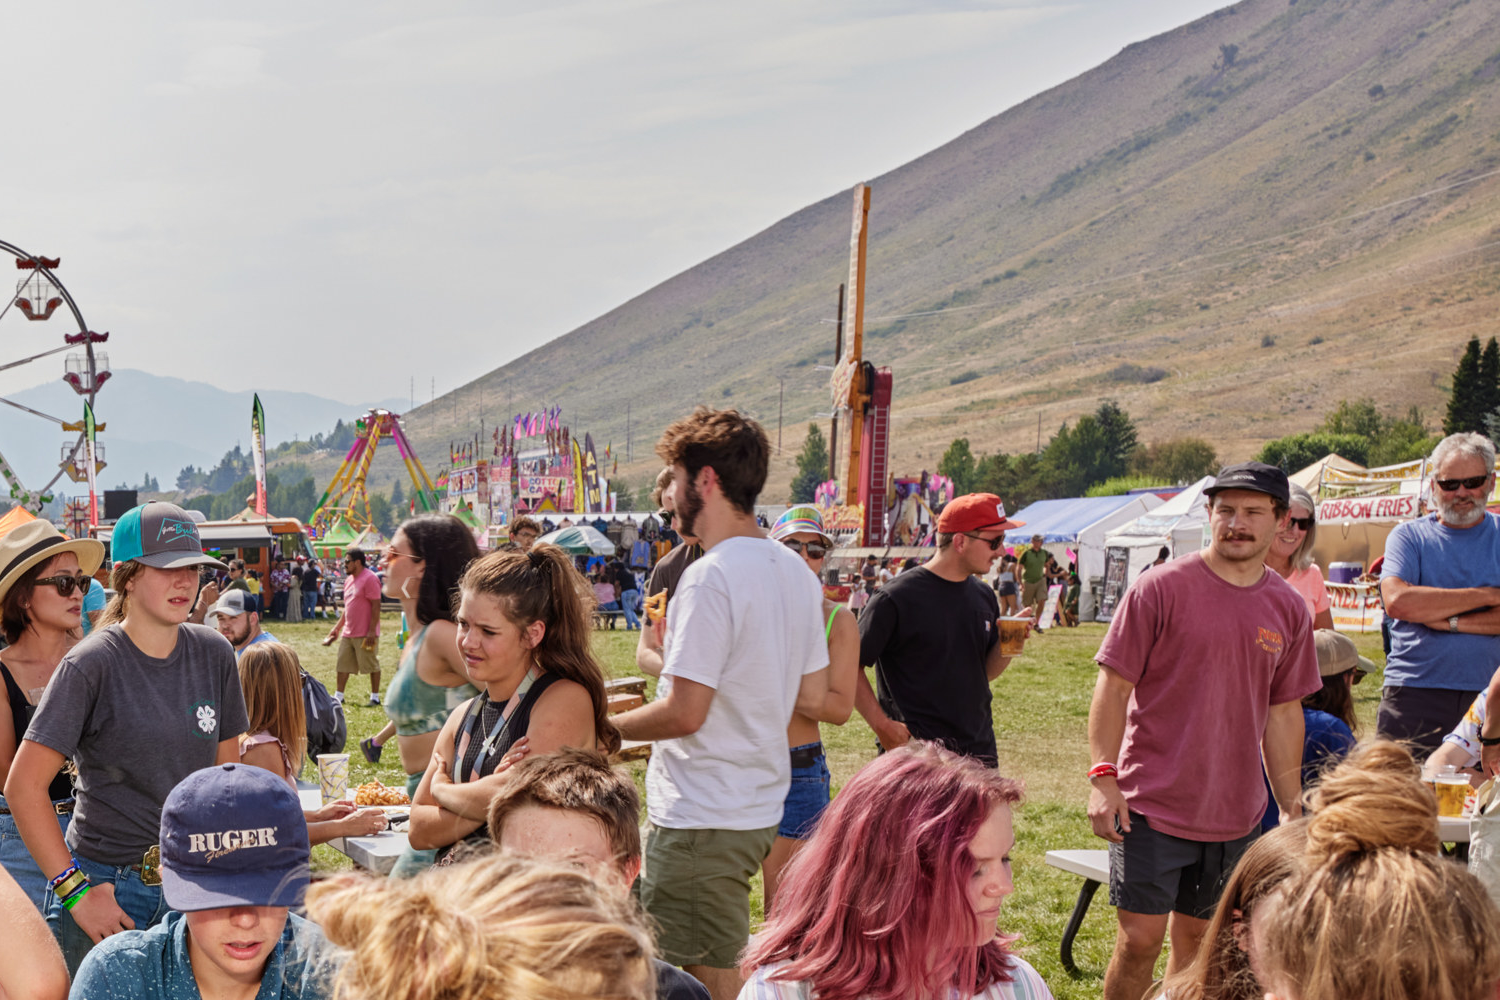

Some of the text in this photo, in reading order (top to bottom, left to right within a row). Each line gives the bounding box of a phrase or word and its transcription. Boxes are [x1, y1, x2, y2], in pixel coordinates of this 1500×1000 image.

[586, 451, 601, 505] ATM
[1320, 496, 1413, 520] RIBBON FRIES
[188, 827, 278, 854] RUGER
